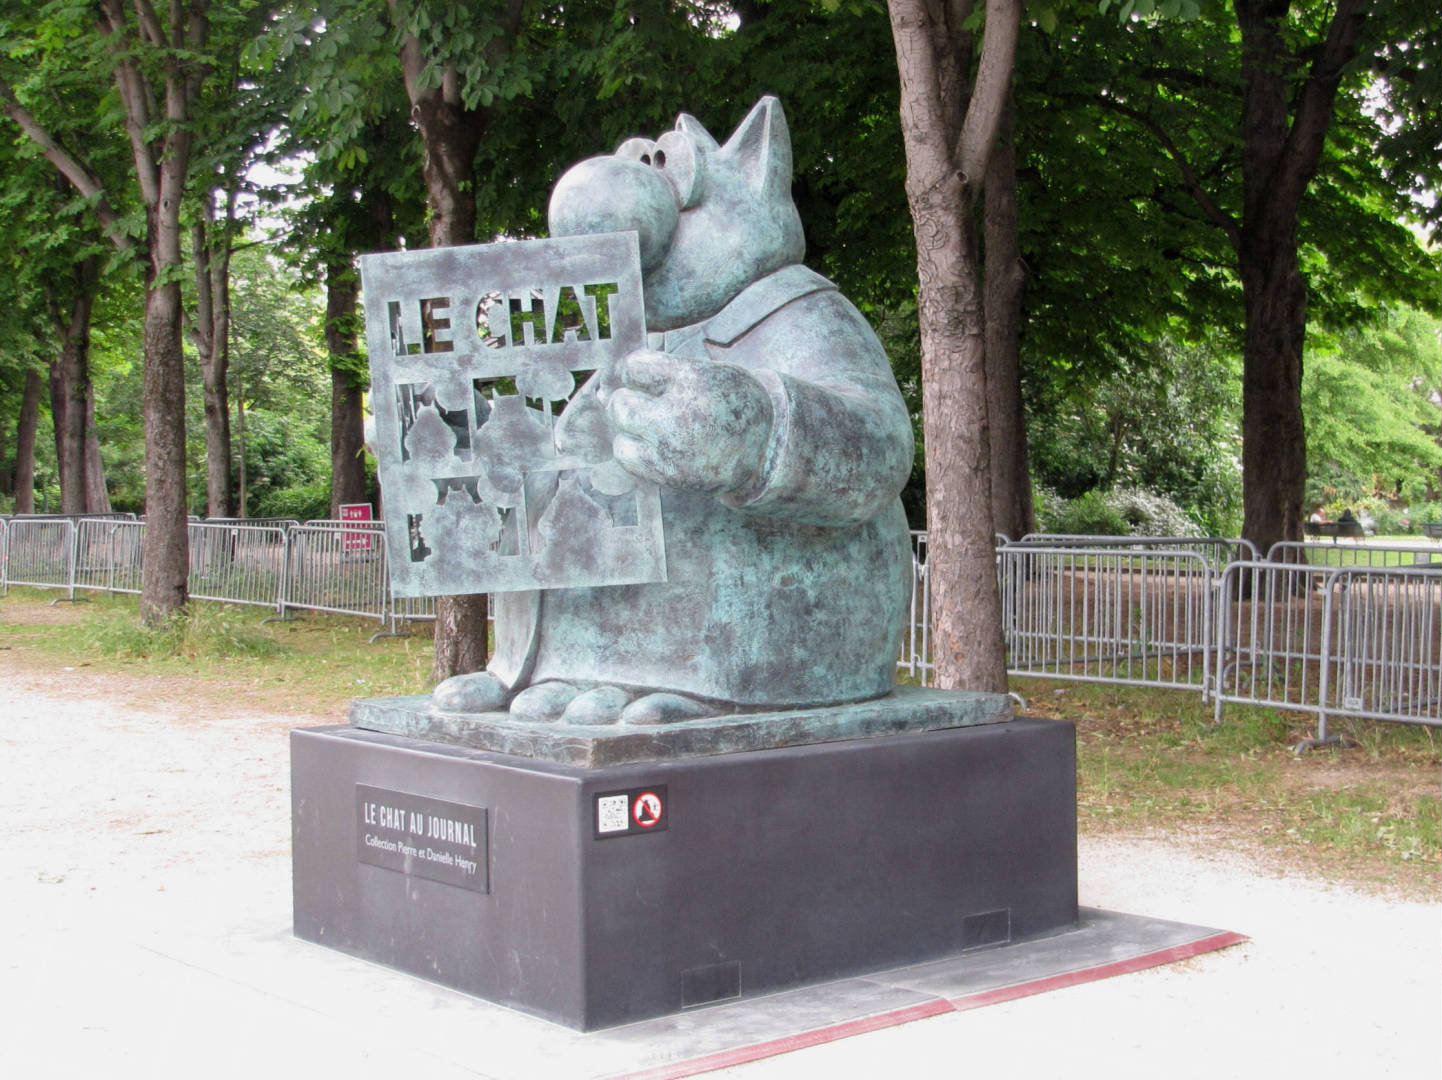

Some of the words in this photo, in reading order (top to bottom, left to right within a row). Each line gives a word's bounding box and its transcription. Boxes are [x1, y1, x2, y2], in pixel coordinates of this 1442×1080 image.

[387, 297, 454, 356] LE
[475, 282, 619, 348] CHAT
[364, 802, 377, 825] LE
[379, 805, 406, 831] CHAT
[410, 812, 424, 836] AU
[427, 815, 477, 848] JOURNAL
[364, 833, 397, 853] Collection
[397, 840, 418, 857] Pierre
[426, 847, 454, 866] Danielle
[454, 853, 478, 875] Henry
